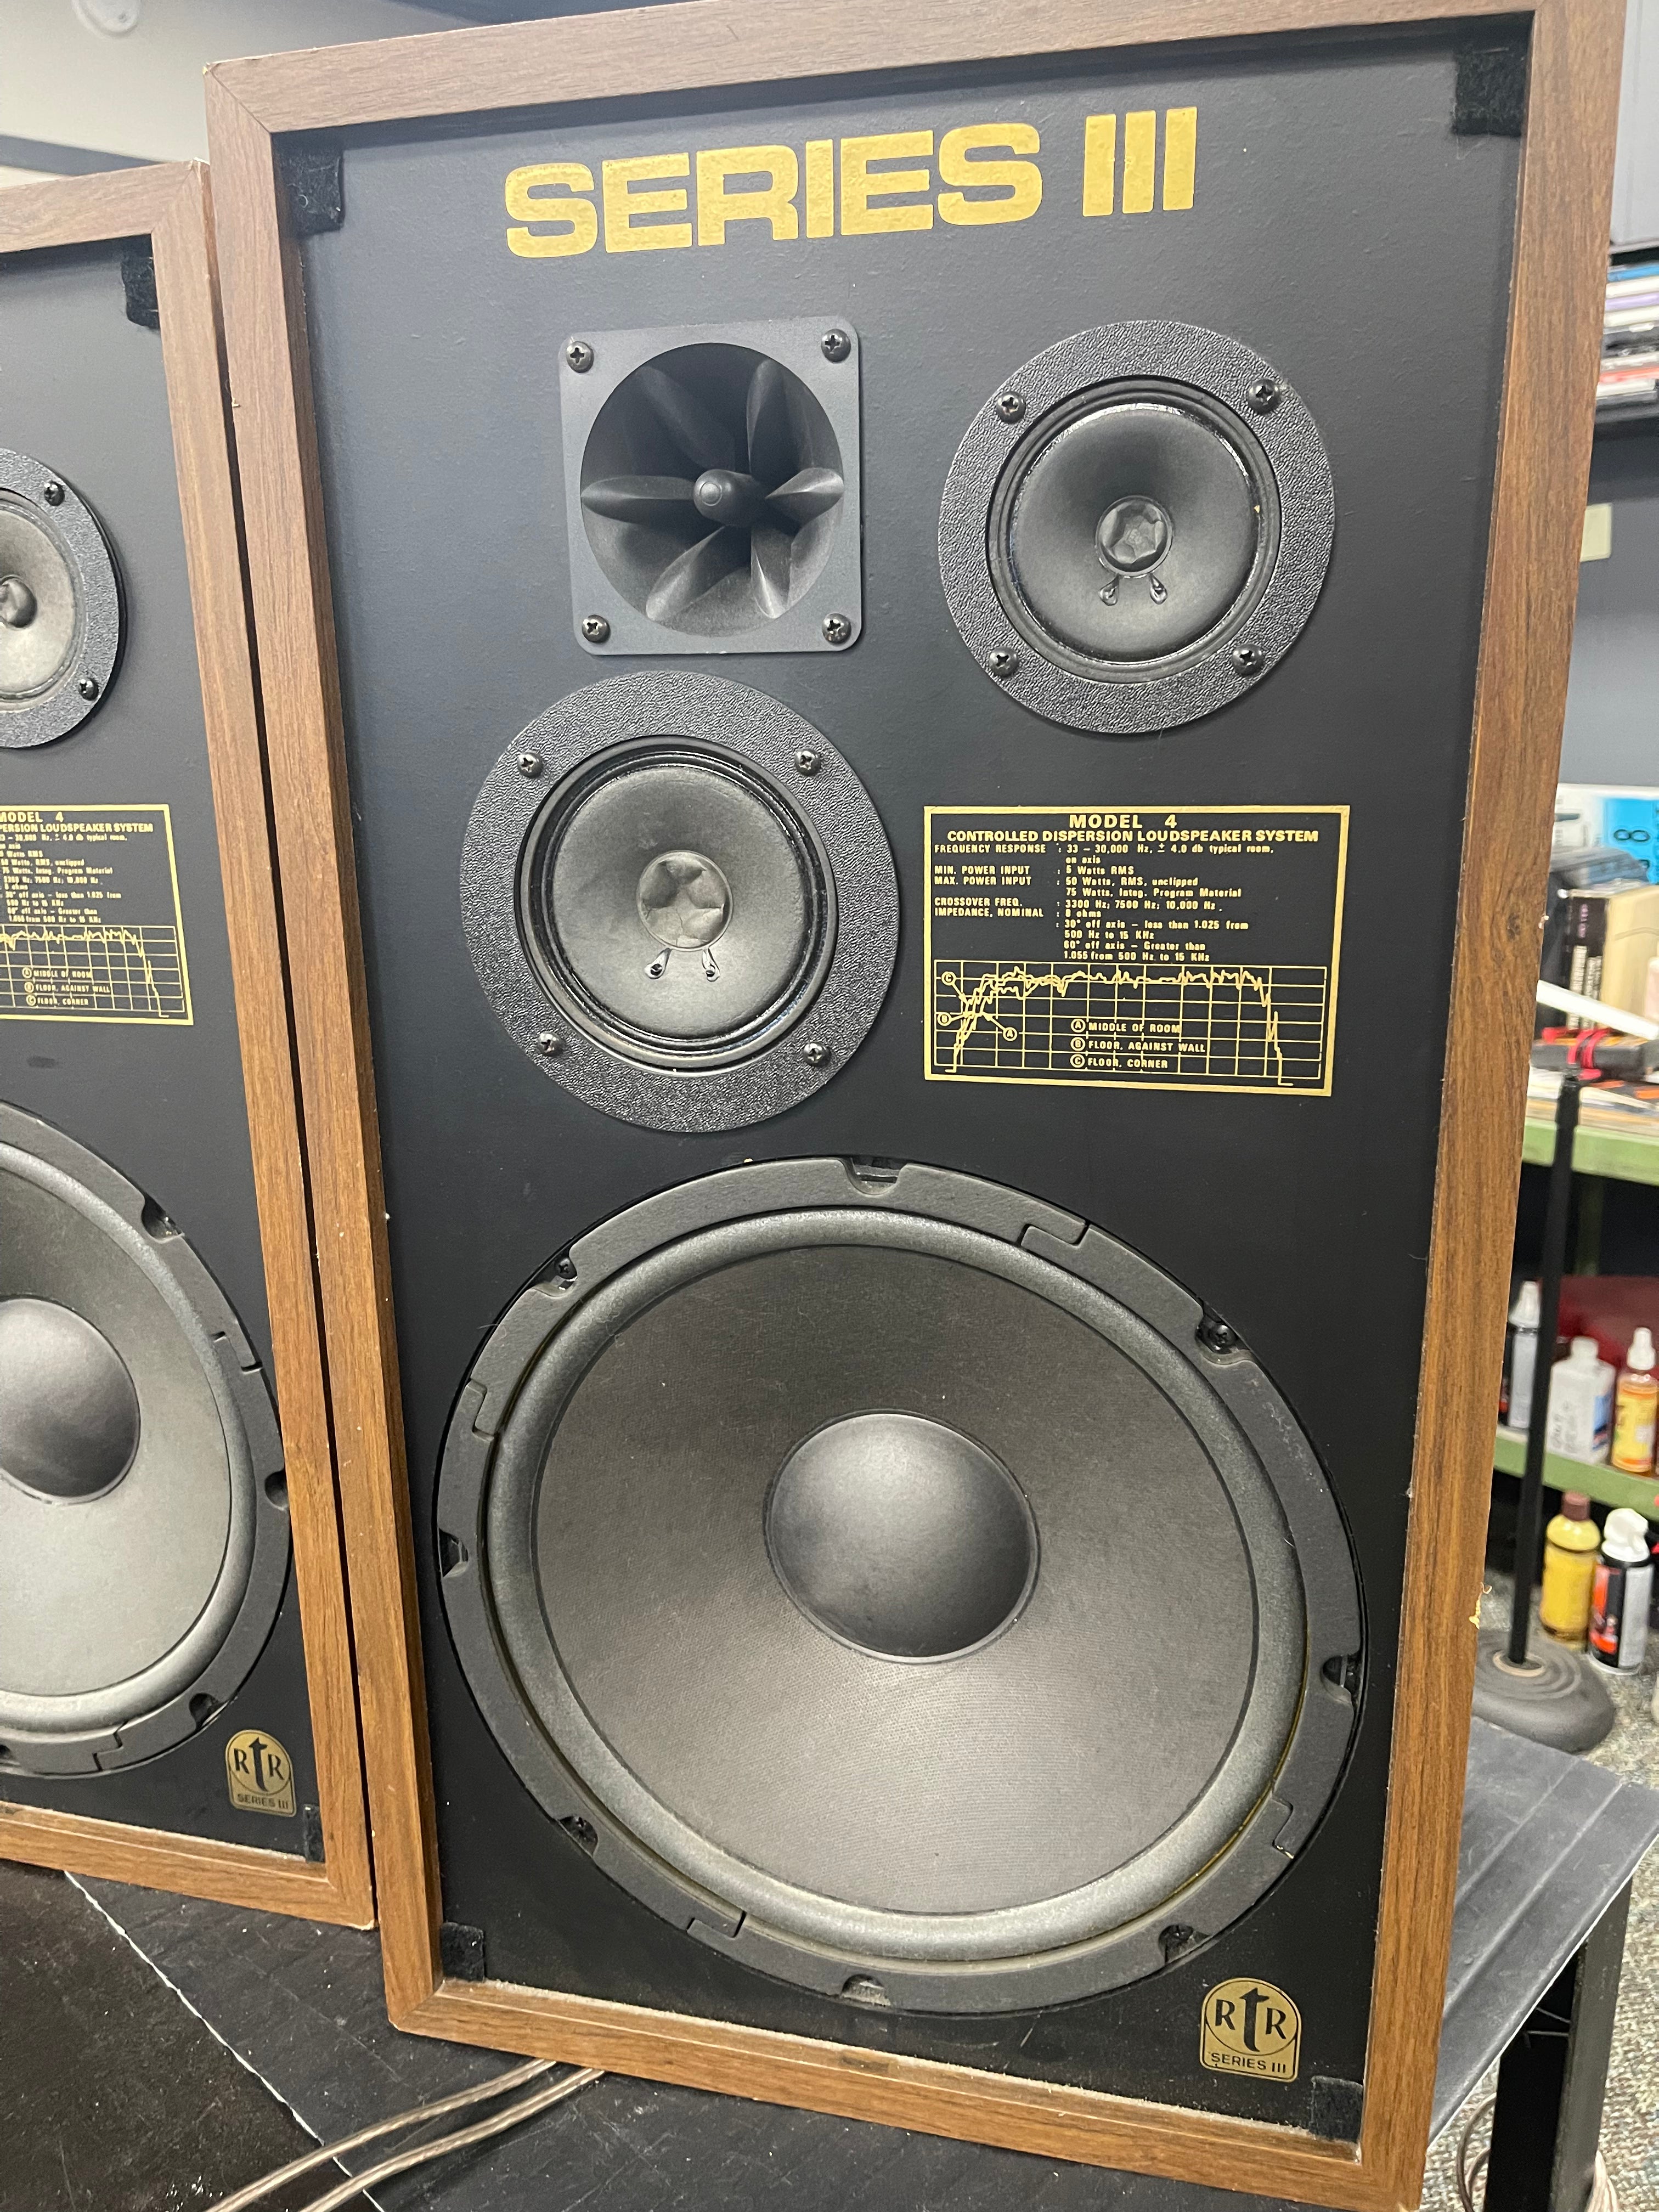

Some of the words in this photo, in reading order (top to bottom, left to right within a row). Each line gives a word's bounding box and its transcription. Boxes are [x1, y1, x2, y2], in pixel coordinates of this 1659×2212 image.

[504, 122, 1042, 259] SERIES
[1082, 106, 1197, 217] III
[55, 812, 64, 822] 4
[1070, 815, 1142, 828] MODEL
[1165, 815, 1177, 828] 4
[40, 823, 112, 832] LOUDSPEAKER
[114, 823, 153, 832] SYSTEM
[947, 831, 1038, 841] CONTROLLED
[1043, 831, 1132, 841] DISPERSION
[1138, 830, 1251, 841] LOUDSPEAKER
[1256, 830, 1318, 842] SYSTEM
[935, 844, 990, 853] FREQUENCY
[996, 844, 1046, 853] RESPONSE
[1067, 844, 1078, 853] 33
[1095, 844, 1128, 854] 30,000
[1171, 844, 1187, 853] 4.0
[1210, 844, 1241, 854] typical
[1082, 855, 1101, 864] axis
[935, 866, 956, 874] MIN.
[962, 866, 995, 874] POWER
[1001, 866, 1030, 874] INPUT
[1066, 865, 1071, 873] 5
[1077, 866, 1105, 874] Watts
[1111, 866, 1133, 874] RMS
[934, 876, 958, 884] MAX.
[963, 877, 996, 885] POWER
[1002, 877, 1031, 885] INPUT
[1066, 877, 1077, 885] 50
[1082, 877, 1114, 886] Watts,
[1121, 877, 1147, 886] RMS,
[1152, 877, 1198, 887] unclipped
[1066, 888, 1076, 896] 75
[1082, 888, 1113, 897] Watts,
[1120, 888, 1147, 898] Integ.
[1154, 888, 1193, 898] Program
[1200, 888, 1241, 897] Material
[935, 898, 990, 906] CROSSOVER
[995, 898, 1022, 906] FREQ.
[1065, 900, 1089, 908] 3300
[1115, 900, 1138, 909] 7500
[1166, 901, 1198, 910] 10,000
[935, 907, 992, 917] IMPEDANCE,
[998, 908, 1043, 917] NOMINAL
[1076, 909, 1101, 917] ohms
[1065, 919, 1080, 928] 30°
[1106, 920, 1125, 928] axis
[1169, 921, 1188, 929] than
[1194, 920, 1219, 929] 1.025
[1226, 921, 1248, 929] from
[1065, 930, 1082, 938] 500
[1088, 930, 1099, 939] Hz
[1120, 931, 1128, 939] 15
[1136, 930, 1154, 939] KHz
[1144, 941, 1179, 950] Greater
[1186, 942, 1205, 950] than
[1064, 951, 1088, 960] 1.055
[1091, 951, 1113, 960] from
[1119, 952, 1136, 960] 500
[1175, 952, 1184, 961] 15
[1191, 953, 1209, 961] KHz
[1088, 1022, 1126, 1032] MIDDLE
[1132, 1023, 1144, 1032] OF
[1149, 1024, 1180, 1033] ROOM
[1128, 1042, 1173, 1051] AGAINST
[1178, 1042, 1205, 1052] WALL
[1127, 1059, 1167, 1068] CORNER
[237, 1793, 275, 1807] SERIES
[278, 1800, 289, 1809] III
[1211, 2052, 1267, 2070] SERIES
[1272, 2062, 1286, 2073] III
